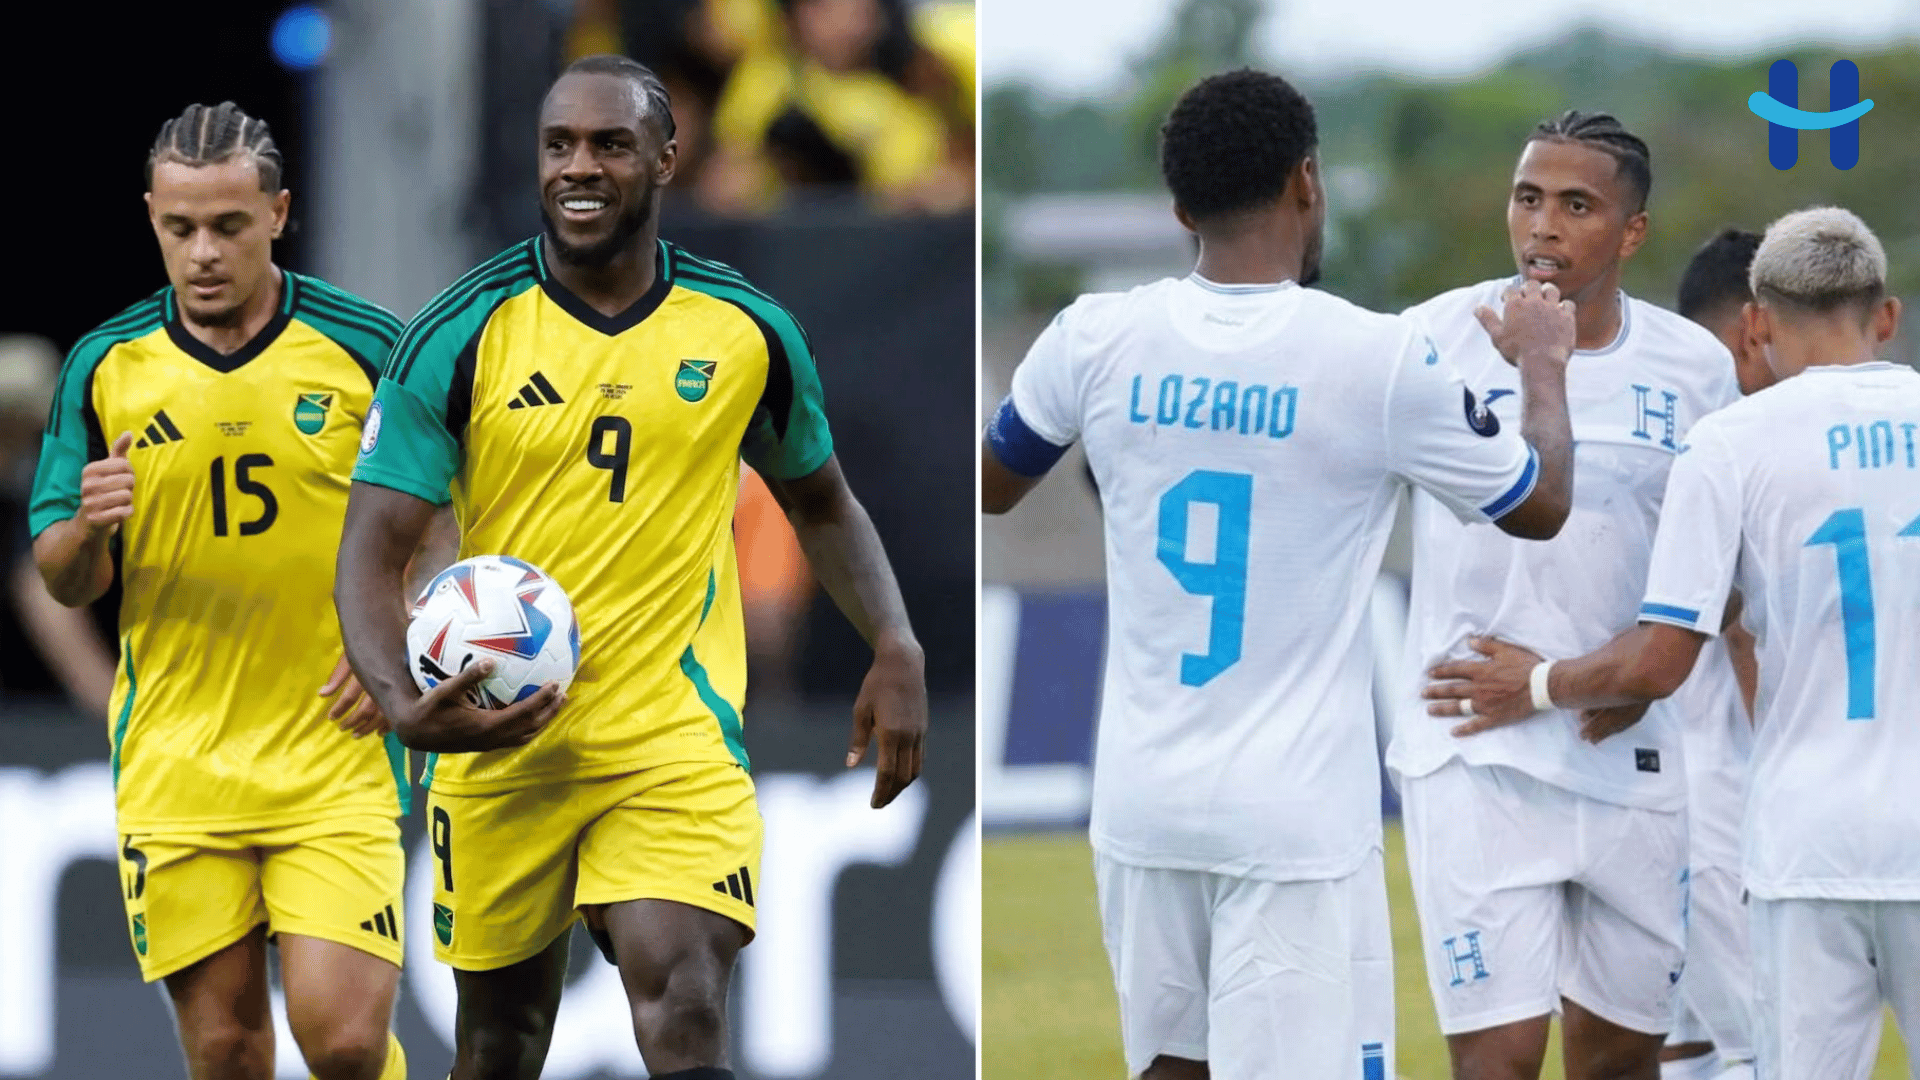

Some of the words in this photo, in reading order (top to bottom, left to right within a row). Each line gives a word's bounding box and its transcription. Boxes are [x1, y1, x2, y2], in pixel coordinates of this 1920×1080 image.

[1130, 373, 1299, 438] LOZANO
[210, 453, 279, 537] 15
[587, 415, 632, 503] 9
[1156, 470, 1254, 688] 9
[432, 805, 454, 893] 9
